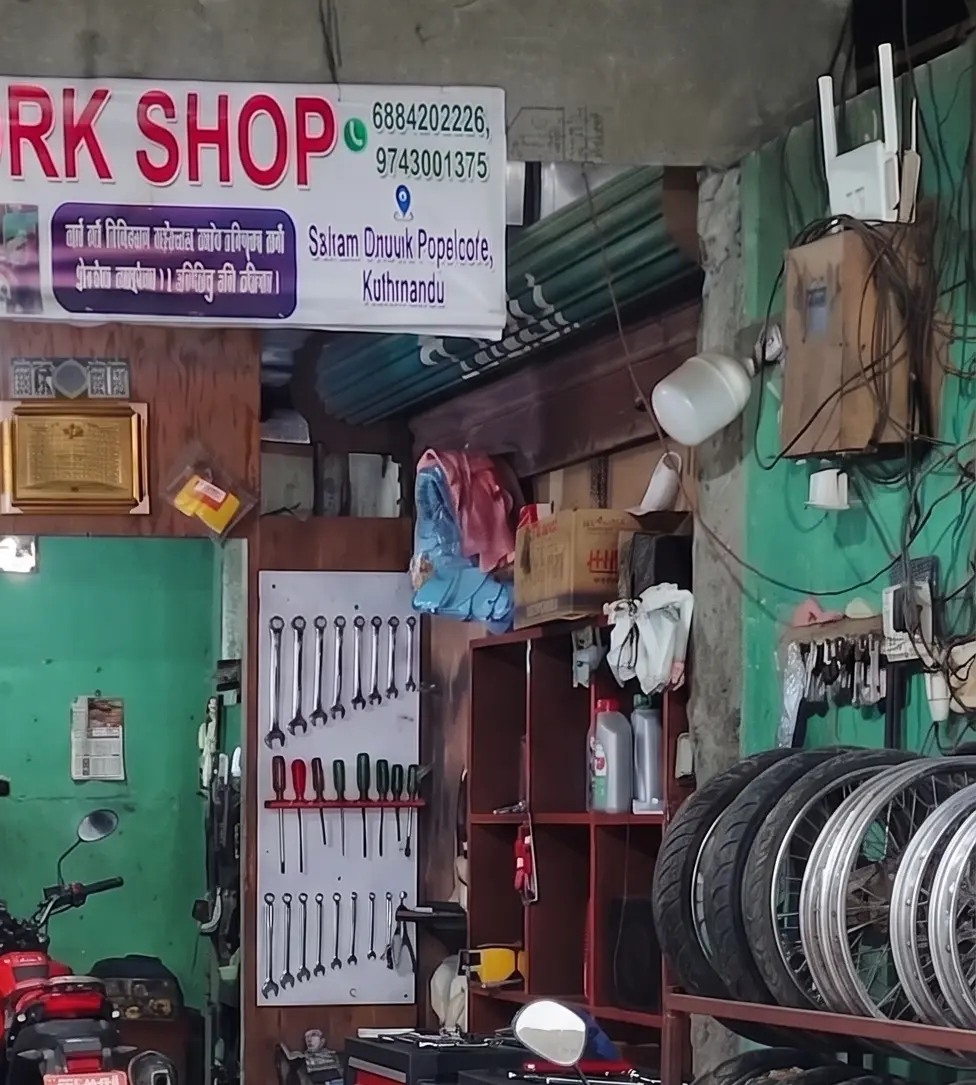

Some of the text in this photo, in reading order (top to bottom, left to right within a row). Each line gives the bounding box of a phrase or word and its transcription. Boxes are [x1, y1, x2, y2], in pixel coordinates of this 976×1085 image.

[136, 90, 336, 187] SHOP
[372, 101, 491, 139] 6884202226,
[376, 147, 488, 179] 9743001375
